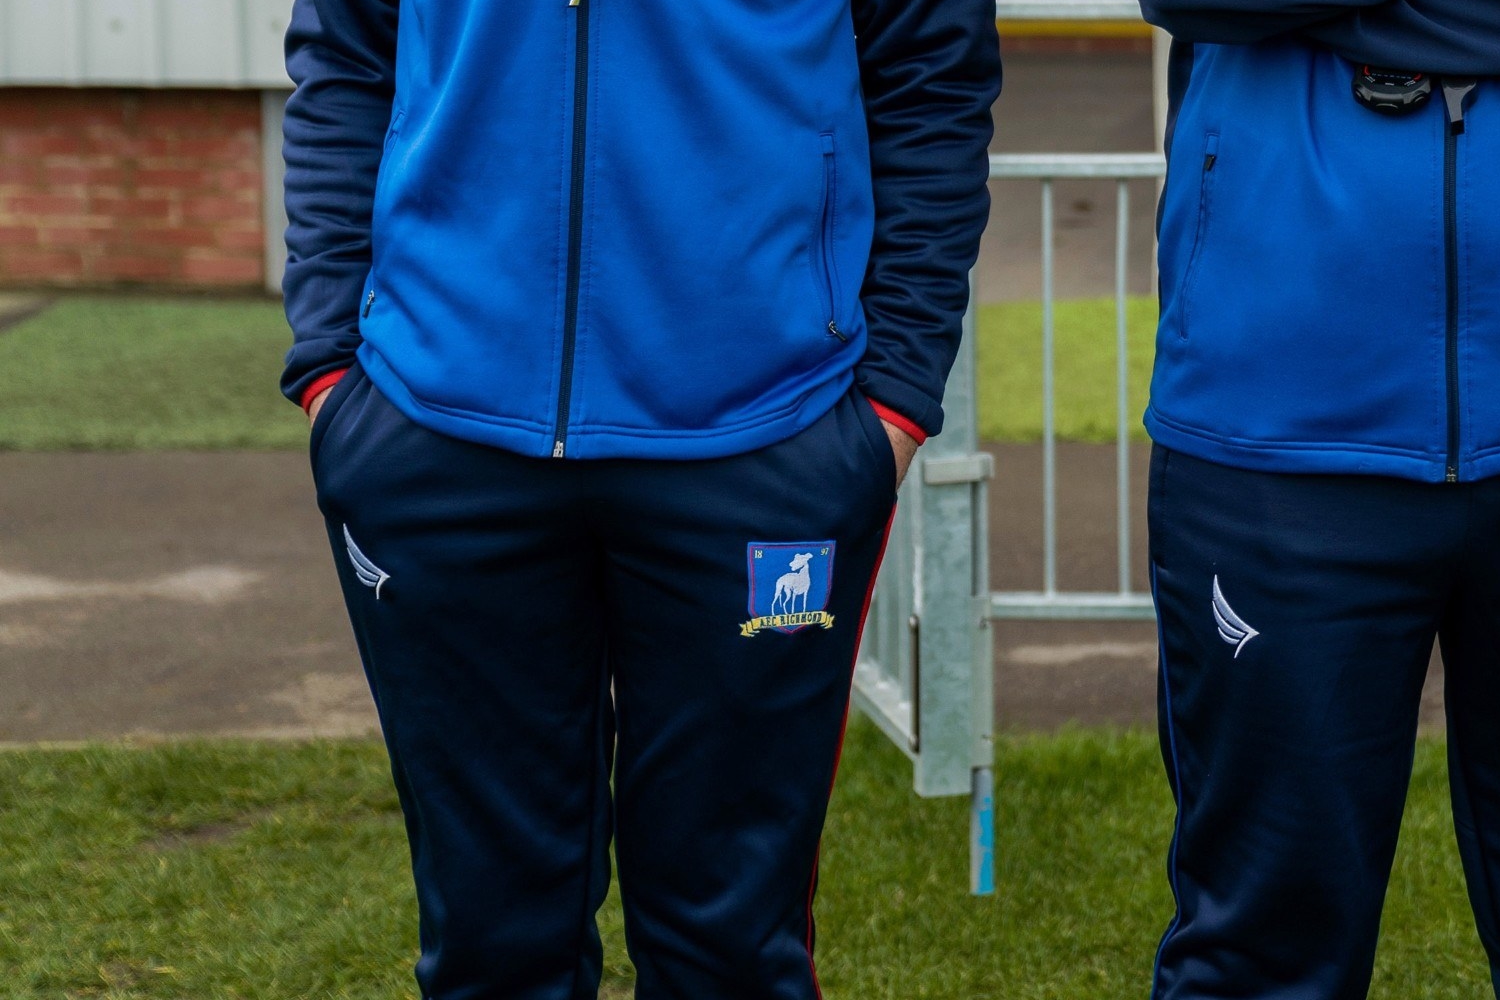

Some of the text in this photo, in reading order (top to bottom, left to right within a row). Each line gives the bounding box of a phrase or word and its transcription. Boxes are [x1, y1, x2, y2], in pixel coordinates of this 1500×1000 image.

[754, 547, 829, 559] 18 97
[780, 612, 822, 625] RICHMOND
